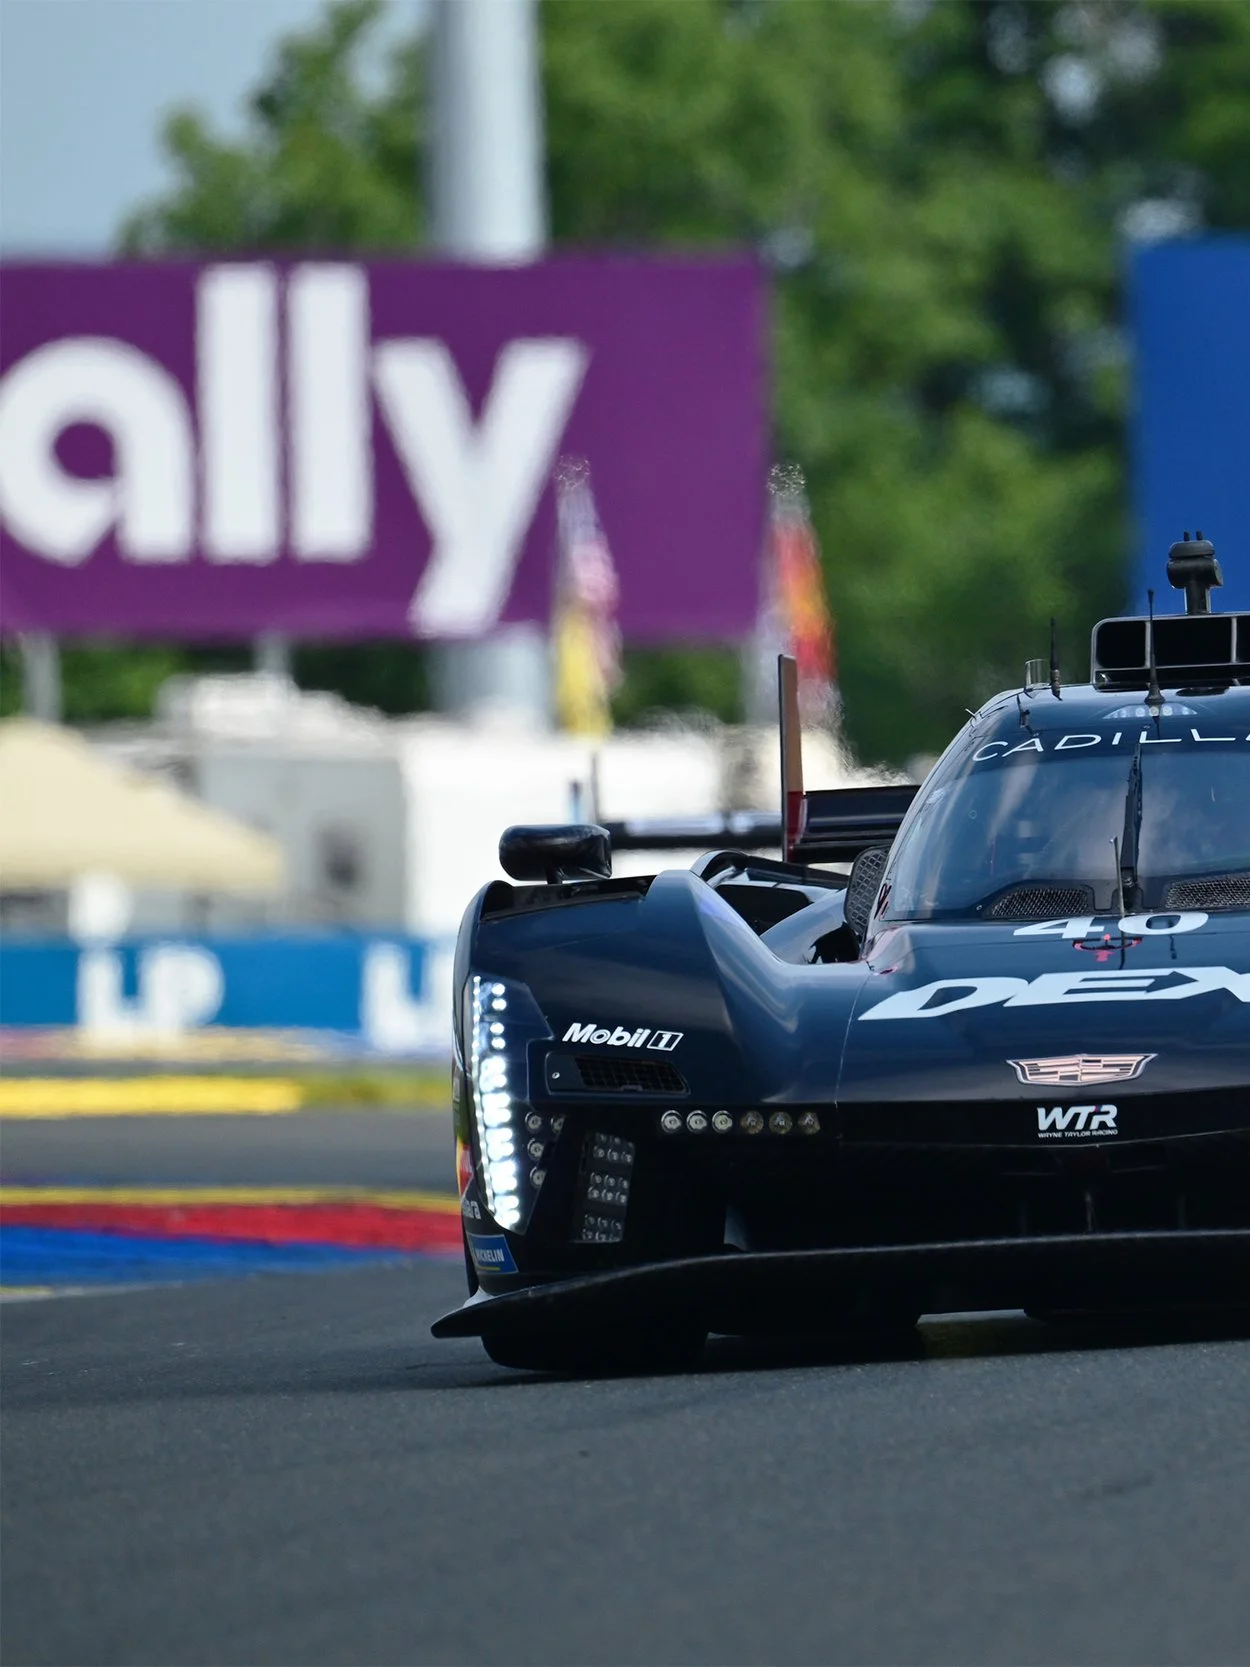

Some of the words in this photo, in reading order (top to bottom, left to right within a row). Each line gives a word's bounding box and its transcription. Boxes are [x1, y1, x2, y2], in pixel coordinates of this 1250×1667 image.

[0, 261, 590, 638] ally
[1013, 912, 1210, 939] 40
[562, 1022, 651, 1048] Mobil
[1036, 1104, 1118, 1131] WTR
[1037, 1131, 1063, 1139] WAYNE
[1064, 1130, 1091, 1138] TAYLOR
